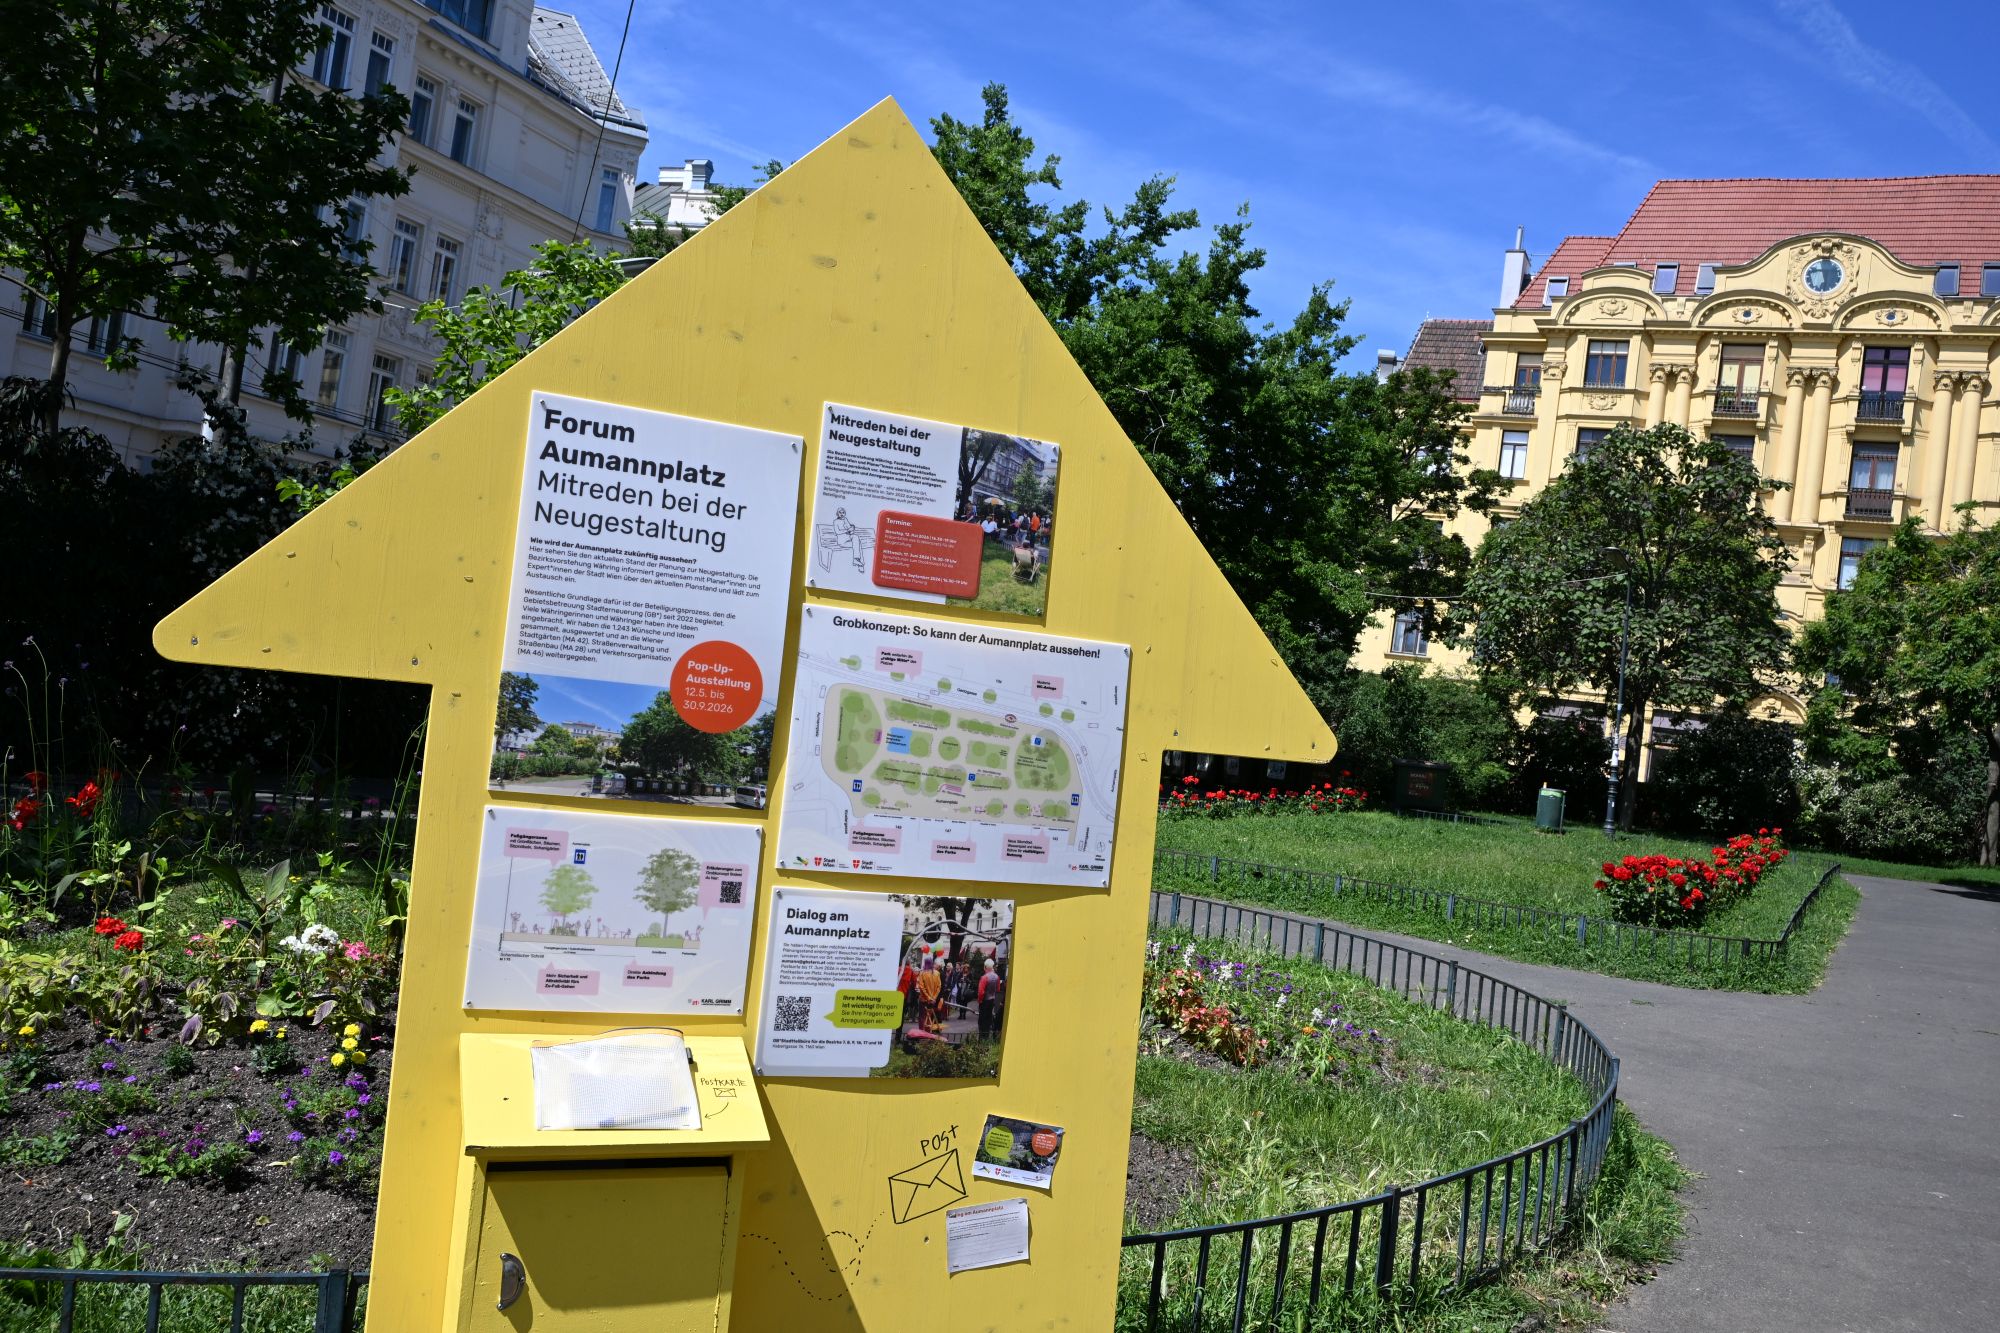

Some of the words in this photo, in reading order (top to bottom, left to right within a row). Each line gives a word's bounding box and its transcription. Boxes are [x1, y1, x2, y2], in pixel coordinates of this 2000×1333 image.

[544, 407, 635, 443] Forum
[830, 412, 886, 433] Mitreden
[889, 423, 908, 436] bei
[910, 428, 931, 440] der
[828, 429, 921, 457] Neugestaltung
[539, 440, 726, 488] Aumannplatz
[538, 470, 653, 507] Mitreden
[661, 488, 698, 514] bei
[706, 496, 747, 520] der
[534, 500, 726, 553] Neugestaltung
[886, 517, 912, 526] Termine:
[574, 542, 623, 555] Aumannplatz
[623, 550, 658, 561] zukünftig
[659, 555, 697, 564] aussehen?
[526, 571, 563, 581] Austausch
[528, 553, 592, 569] Bezirksvorstehung
[593, 562, 620, 573] Währing
[621, 565, 654, 576] informiert
[655, 571, 693, 581] gemeinsam
[593, 554, 624, 563] aktuellen
[625, 557, 646, 566] Stand
[658, 562, 686, 573] Planung
[698, 567, 747, 581] Neugestaltung.
[586, 569, 605, 578] Stadt
[653, 579, 684, 588] aktuellen
[684, 582, 718, 592] Planstand
[524, 588, 566, 599] Wesentliche
[566, 593, 602, 604] Grundlage
[522, 605, 540, 613] Viele
[609, 615, 643, 626] Währinger
[644, 619, 665, 627] haben
[666, 622, 679, 630] ihre
[523, 596, 585, 611] Gebietsbetreuung
[586, 604, 644, 618] Stadterneuerung
[676, 614, 694, 623] 2022
[694, 617, 723, 626] begleitet.
[521, 614, 564, 624] eingebracht.
[631, 626, 661, 636] Wünsche
[561, 628, 605, 638] ausgewertet
[641, 636, 664, 644] Wiener
[519, 630, 561, 641] Stadtgärten
[562, 634, 576, 643] (MA
[591, 638, 655, 653] Straßenverwaltung
[832, 615, 910, 636] Grobkonzept:
[912, 625, 928, 637] So
[930, 627, 957, 640] kann
[958, 631, 977, 643] der
[978, 634, 1048, 652] Aumannplatz
[1049, 645, 1100, 659] aussehen!
[518, 639, 559, 650] Straßenbau
[559, 643, 573, 651] (MA
[602, 648, 671, 662] Verkehrsorganisation
[545, 652, 597, 662] weitergegeben.
[687, 660, 733, 675] Pop-Up-
[684, 686, 707, 698] 12.5.
[710, 689, 725, 699] bis
[685, 673, 751, 691] Ausstellung
[682, 699, 733, 714] 30.9.2026
[786, 908, 827, 923] Dialog
[829, 912, 849, 922] am
[784, 924, 870, 940] Aumannplatz
